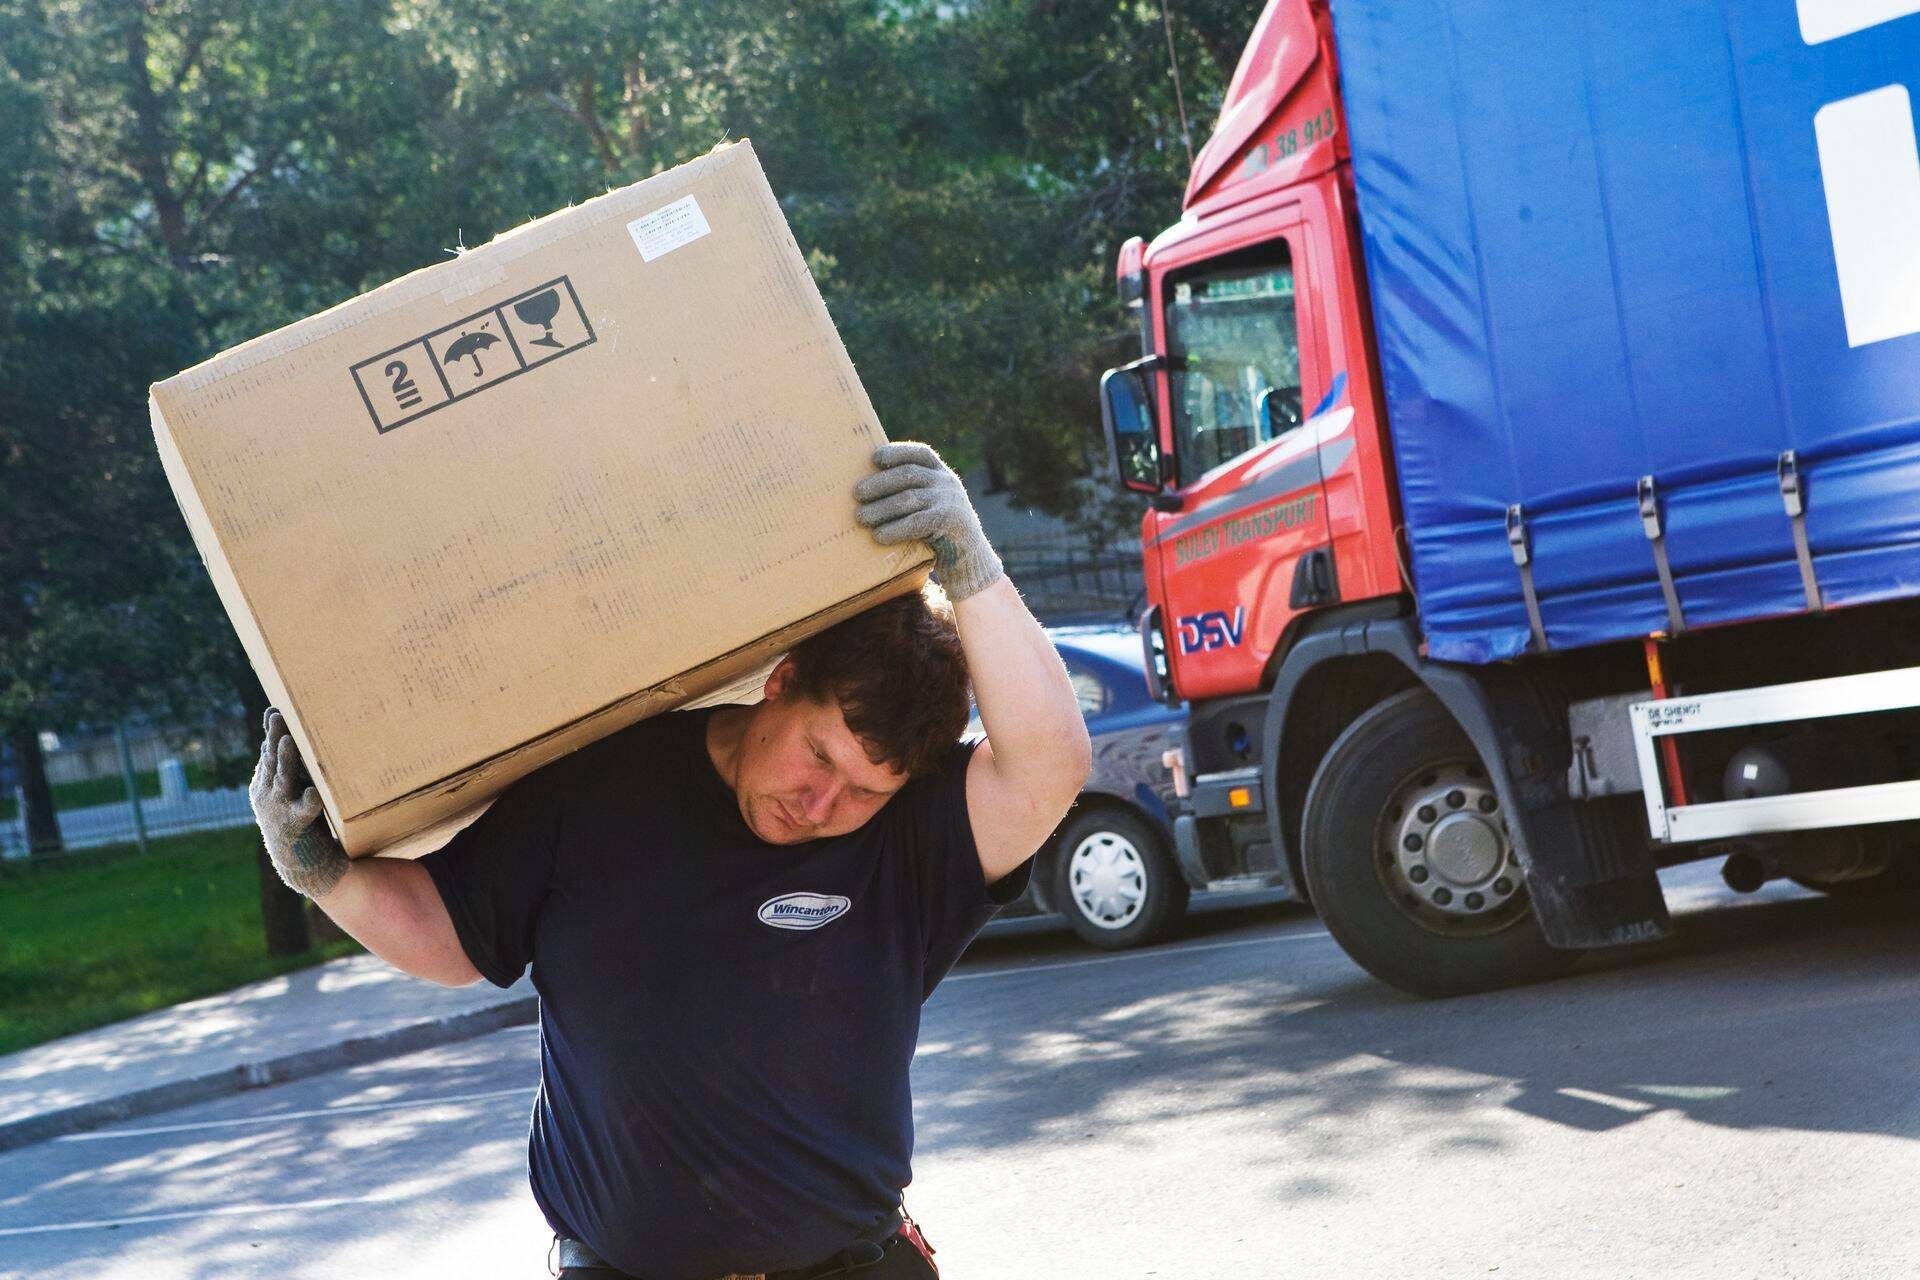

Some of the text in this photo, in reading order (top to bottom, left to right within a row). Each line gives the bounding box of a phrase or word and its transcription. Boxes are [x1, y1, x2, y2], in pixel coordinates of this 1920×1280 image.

[1304, 107, 1335, 147] 913
[385, 360, 416, 394] 2
[1175, 493, 1316, 566] SULEV TRANSPORT
[1176, 606, 1245, 656] DSV
[773, 904, 840, 916] Wincanton
